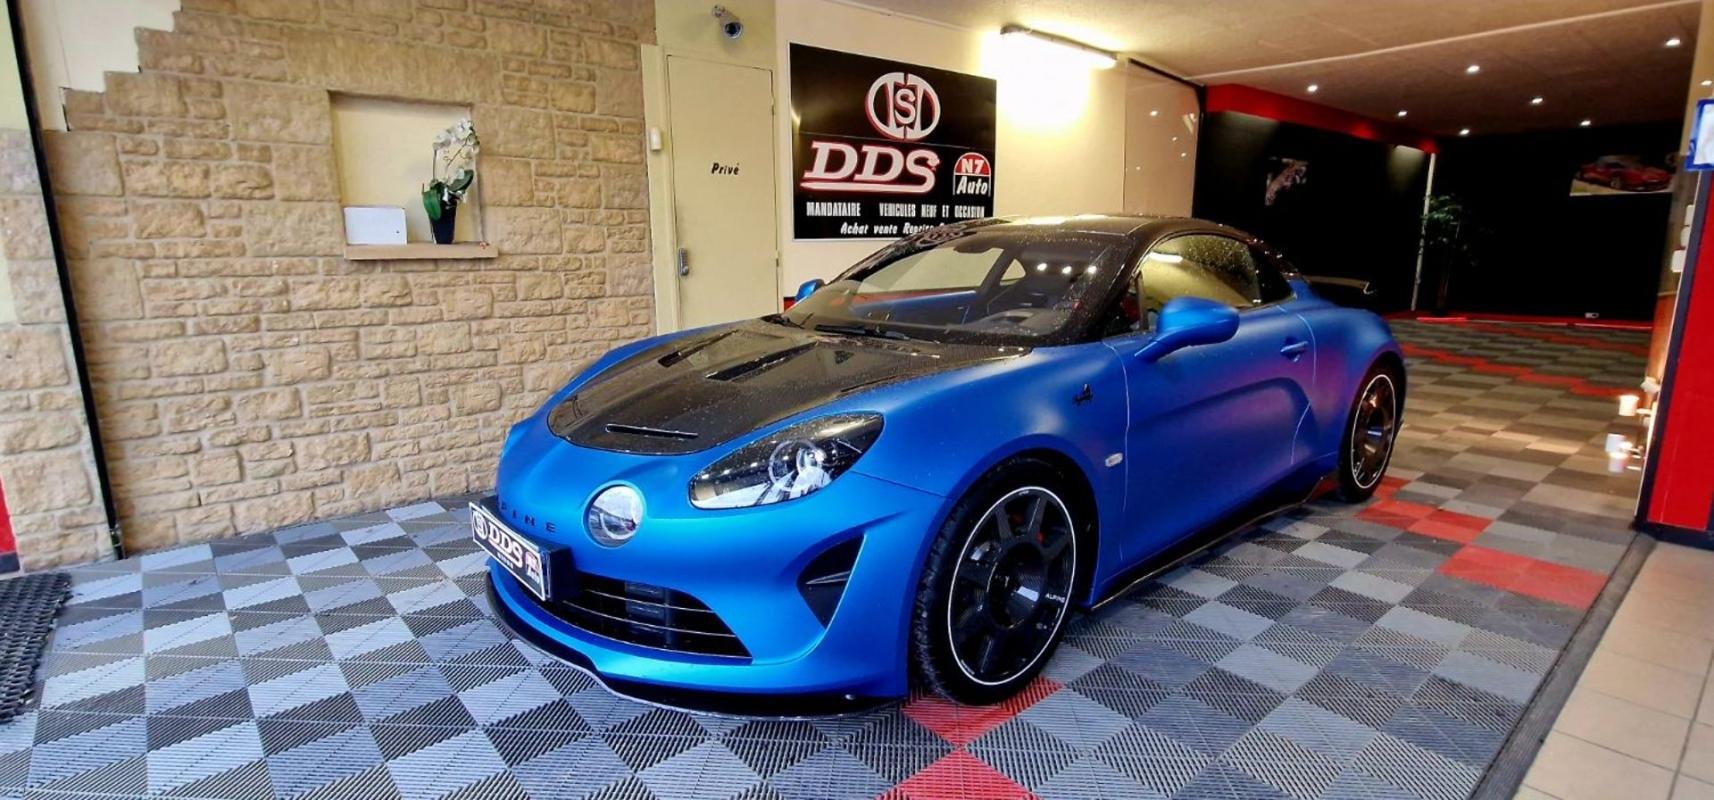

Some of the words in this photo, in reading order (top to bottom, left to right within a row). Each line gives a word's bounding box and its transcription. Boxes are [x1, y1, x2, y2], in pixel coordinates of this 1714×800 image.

[711, 162, 740, 175] Privé
[800, 140, 940, 193] DDS
[961, 159, 984, 174] N7
[956, 176, 988, 195] Auto
[806, 202, 861, 217] MANDATAIRE
[879, 202, 916, 217] VEHICULES
[921, 204, 937, 218] NEUF
[942, 205, 950, 218] ET
[954, 205, 985, 218] OCCASION
[840, 221, 869, 235] Achat
[873, 224, 898, 234] vente
[488, 521, 523, 568] DDS
